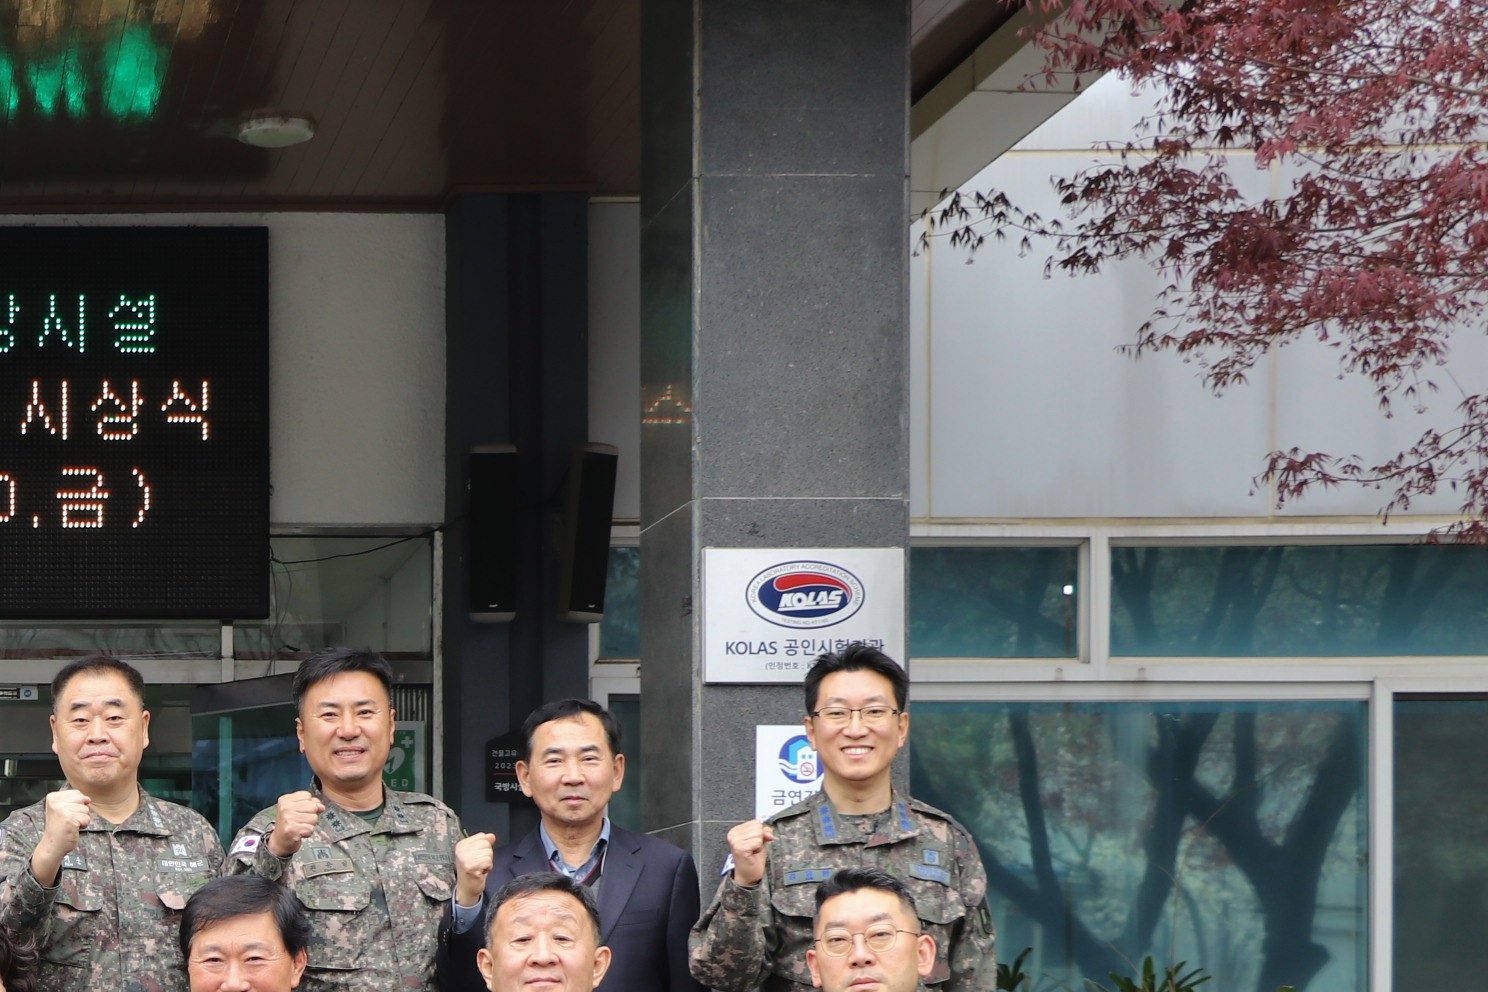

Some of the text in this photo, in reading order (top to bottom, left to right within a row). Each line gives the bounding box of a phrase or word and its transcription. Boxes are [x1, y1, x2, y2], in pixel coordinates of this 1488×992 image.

[21, 380, 209, 441] 시상식
[759, 564, 800, 582] LABORATORY
[801, 564, 850, 581] ACCREDITATION
[778, 590, 844, 609] KOLAS
[725, 641, 778, 655] KOLAS
[390, 779, 409, 787] ED
